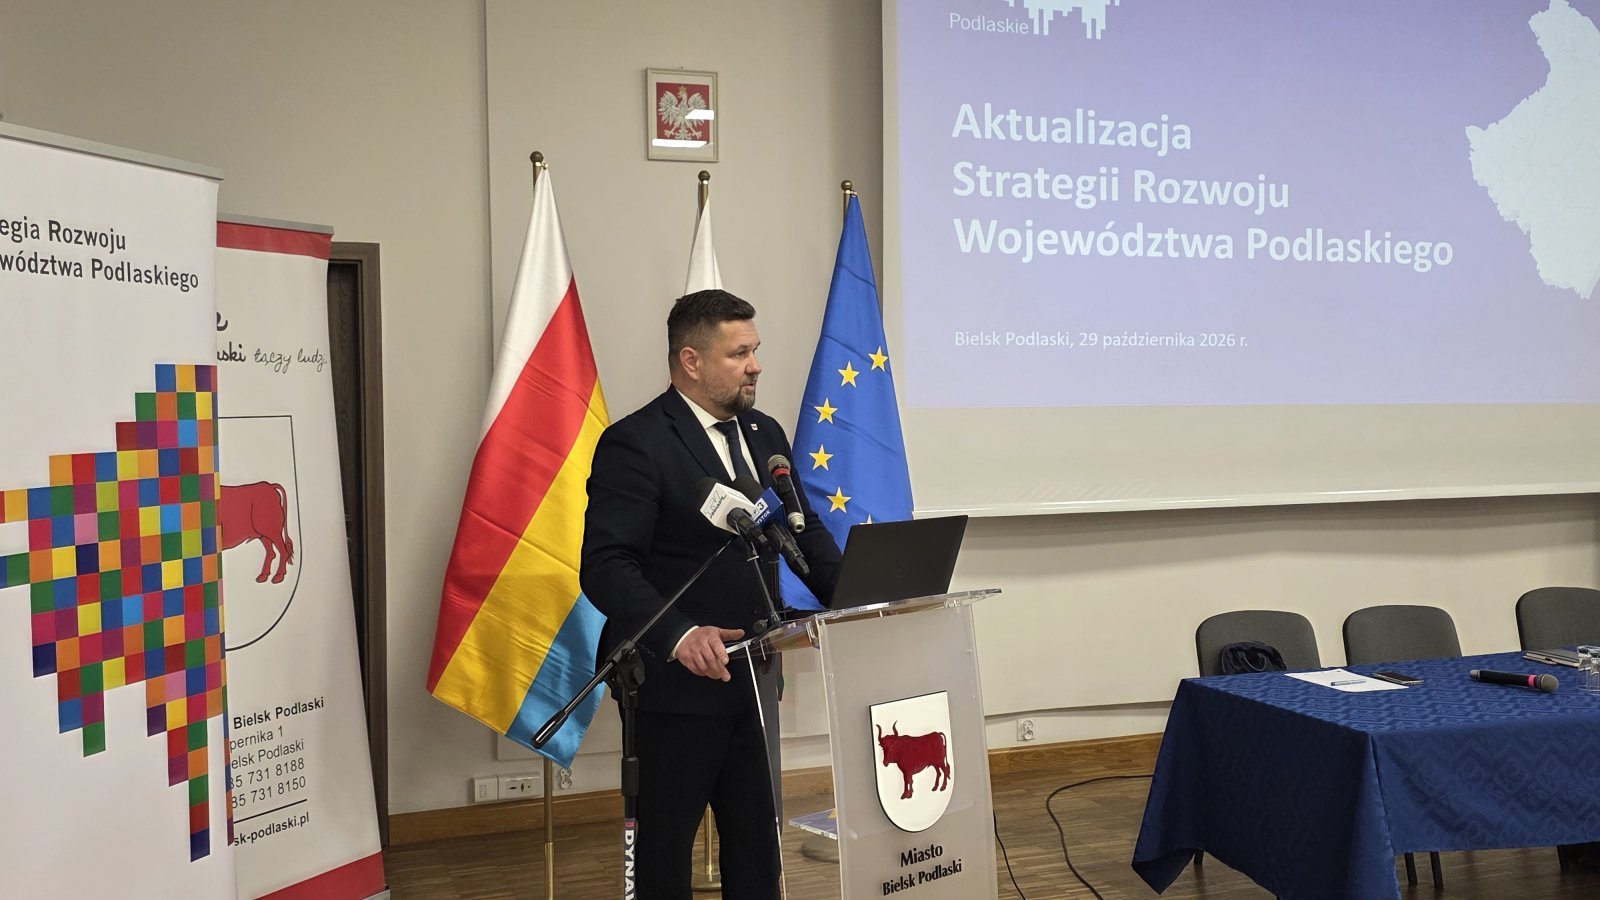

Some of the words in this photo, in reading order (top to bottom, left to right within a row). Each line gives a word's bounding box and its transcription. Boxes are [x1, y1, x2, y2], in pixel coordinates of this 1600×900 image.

[949, 12, 1030, 35] Podlaskie
[951, 103, 1192, 157] Aktualizacja
[952, 162, 1120, 209] Strategii
[1133, 170, 1290, 215] Rozwoju
[0, 216, 41, 243] egia
[48, 219, 126, 254] Rozwoju
[953, 218, 1235, 264] Województwa
[1247, 228, 1454, 273] Podlaskiego
[0, 250, 83, 278] wództwa
[91, 258, 199, 293] Podlaskiego
[954, 331, 1001, 347] Bielsk
[1005, 331, 1075, 349] Podlaski,
[1079, 332, 1098, 347] 29
[1103, 330, 1196, 350] października
[1199, 332, 1236, 347] 2026
[1240, 335, 1249, 347] r.
[233, 710, 271, 731] Bielsk
[275, 696, 325, 720] Podlaski
[229, 729, 274, 754] pernika
[277, 725, 284, 738] 1
[231, 753, 255, 770] elsk
[258, 738, 305, 763] Podlaski
[248, 767, 271, 785] 731
[275, 757, 306, 777] 8188
[250, 786, 273, 804] 731
[277, 775, 307, 795] 8150
[234, 811, 310, 847] sk-podlaski.pl
[900, 843, 944, 868] Miasto
[882, 873, 916, 897] Bielsk
[918, 858, 963, 885] Podlaski
